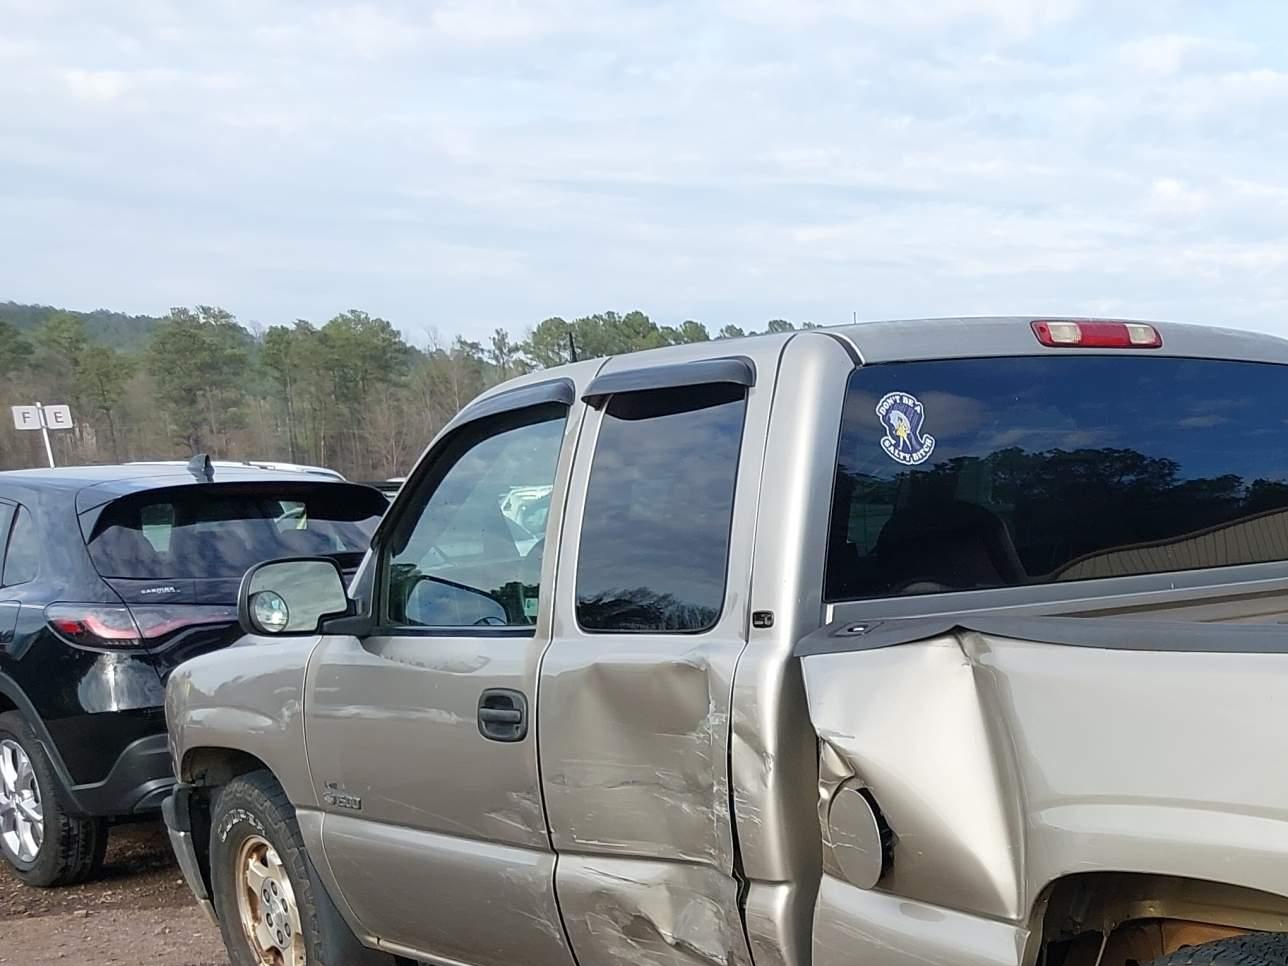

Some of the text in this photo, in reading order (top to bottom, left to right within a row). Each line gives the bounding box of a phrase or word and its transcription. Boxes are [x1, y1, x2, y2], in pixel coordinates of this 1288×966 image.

[879, 395, 921, 416] DON'T BE A
[22, 411, 32, 424] F
[54, 411, 64, 423] E
[883, 438, 932, 462] SALTY BITCH
